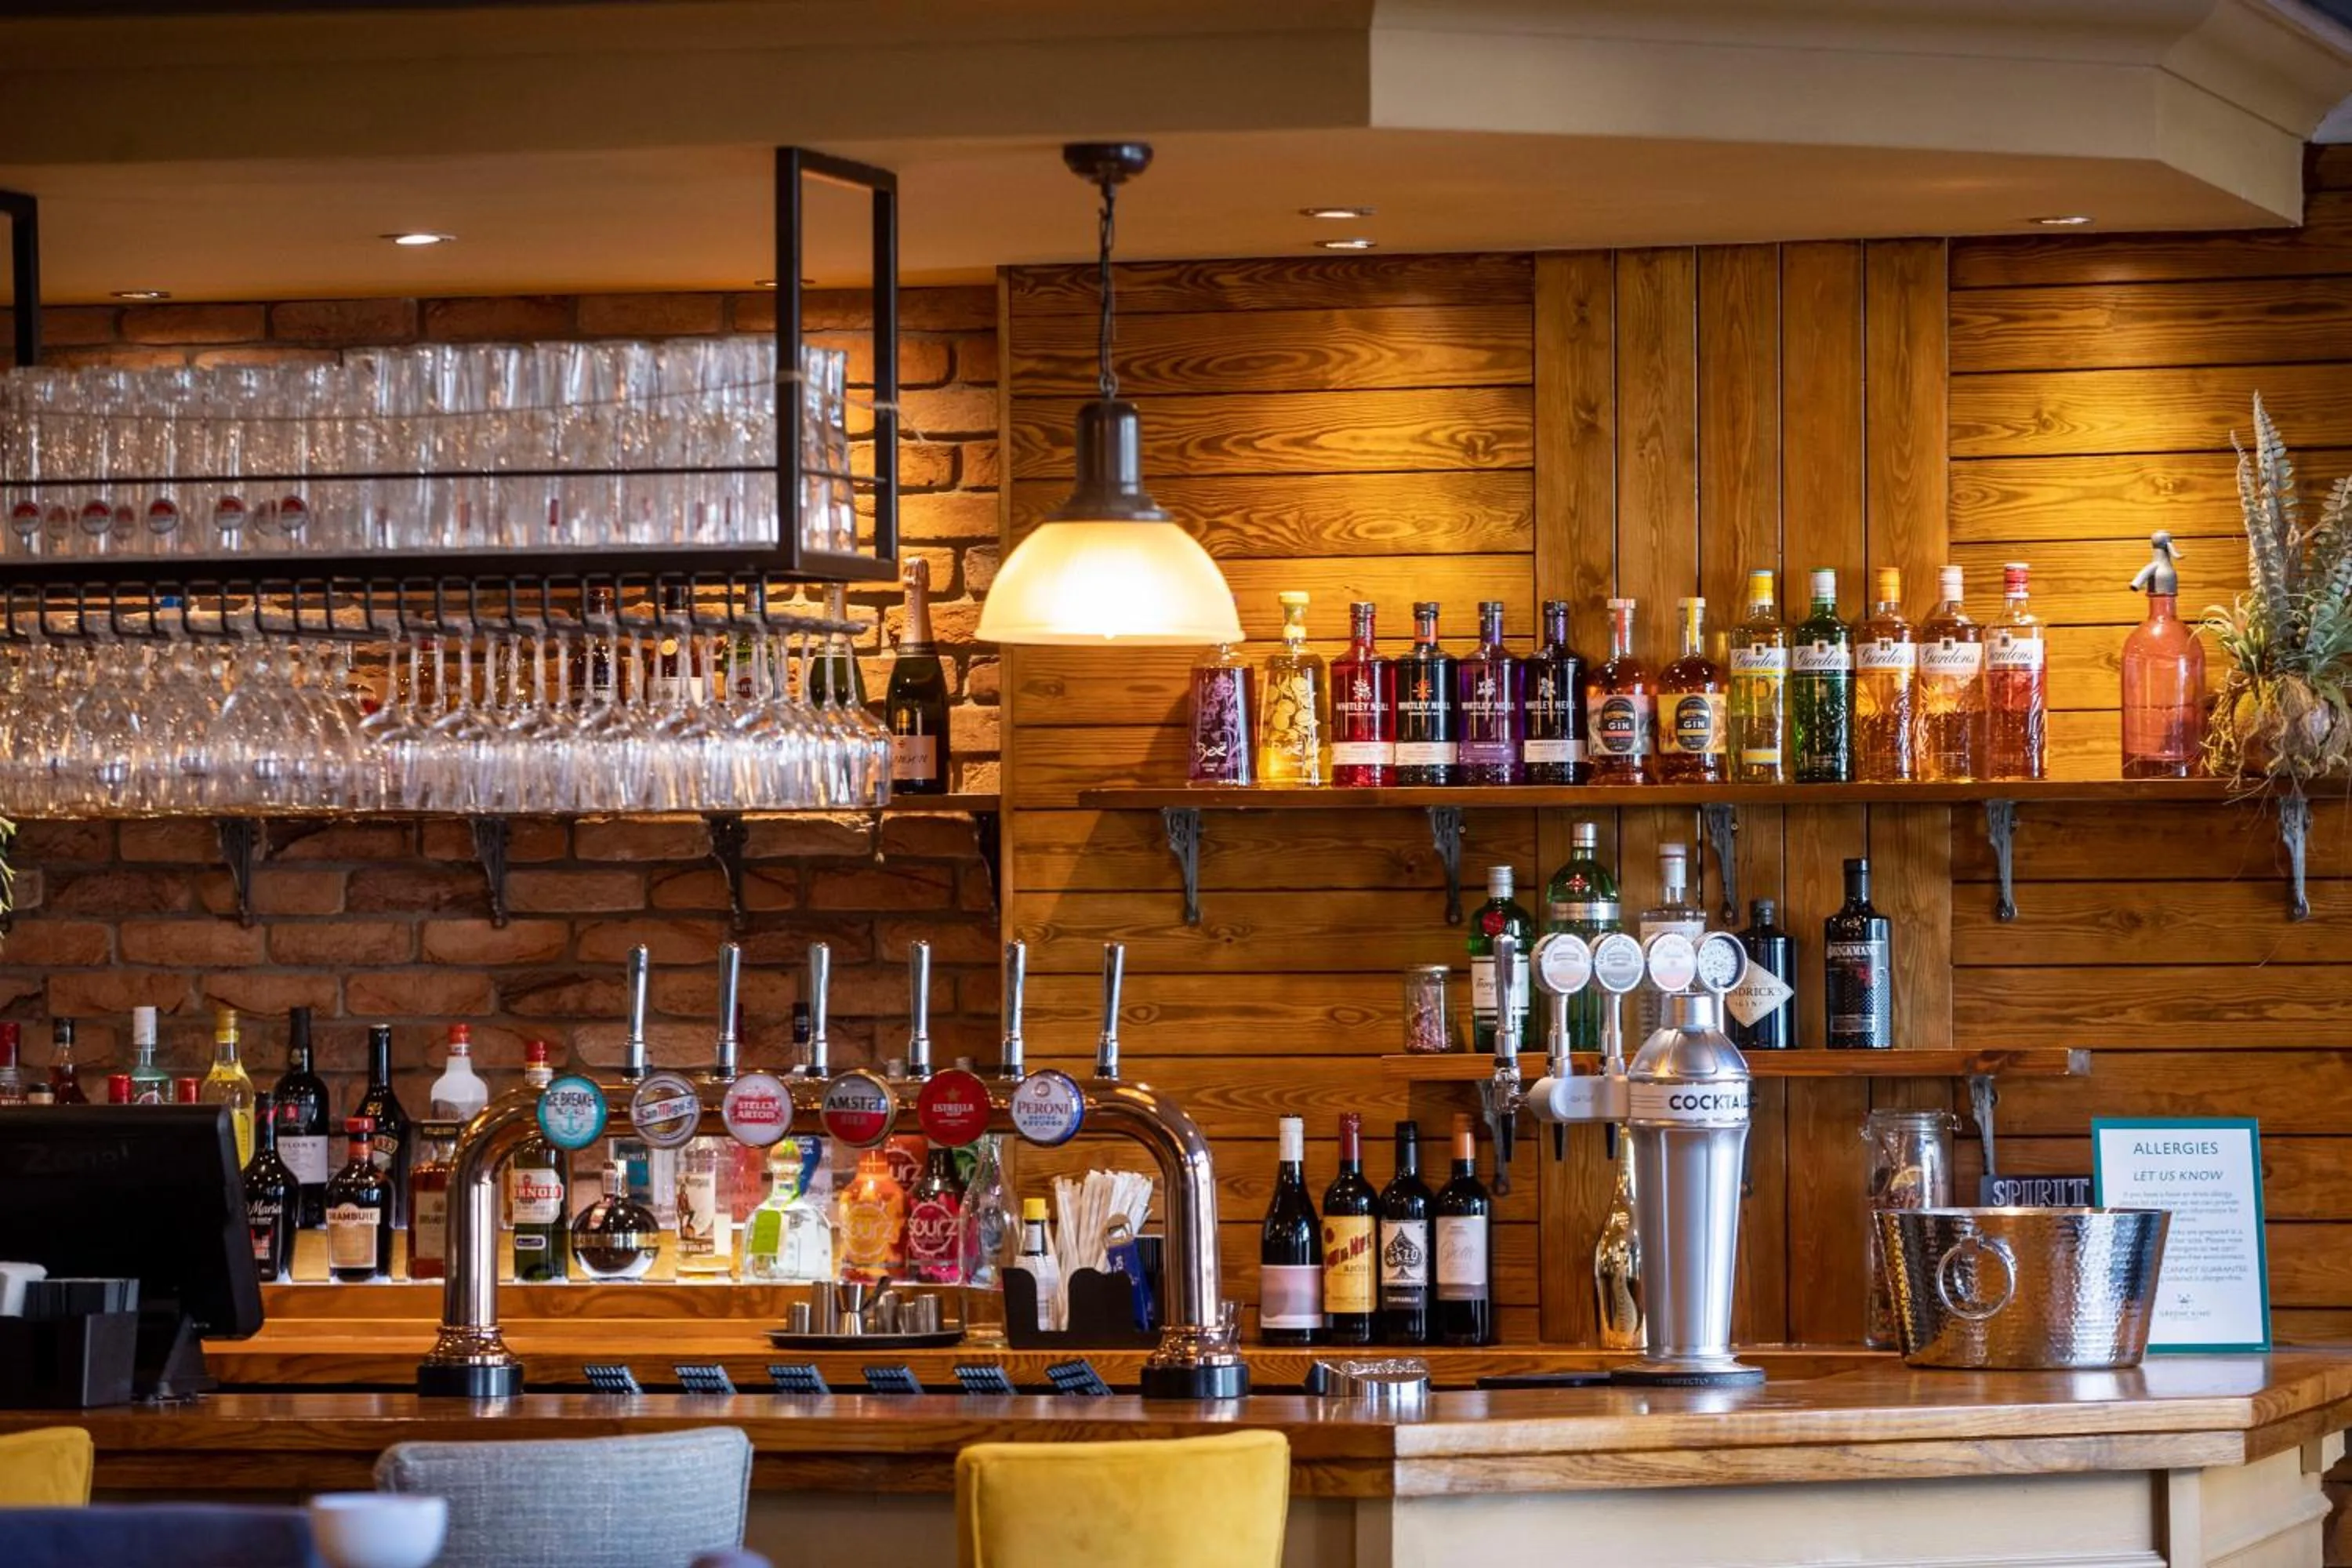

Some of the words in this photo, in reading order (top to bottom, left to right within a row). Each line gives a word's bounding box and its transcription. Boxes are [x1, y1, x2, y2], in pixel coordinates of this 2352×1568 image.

[1609, 721, 1630, 730] GIN
[1684, 720, 1705, 729] GIN
[737, 1101, 779, 1111] STELLA
[932, 1103, 975, 1113] ESTRELLA
[1018, 1101, 1069, 1116] PERONI
[736, 1110, 776, 1119] ARTOIS
[2132, 1142, 2219, 1155] ALLERGIES
[2132, 1171, 2157, 1181] LET
[2158, 1171, 2176, 1181] US
[2178, 1170, 2224, 1181] KNOW
[1991, 1178, 2090, 1207] SPIRIT
